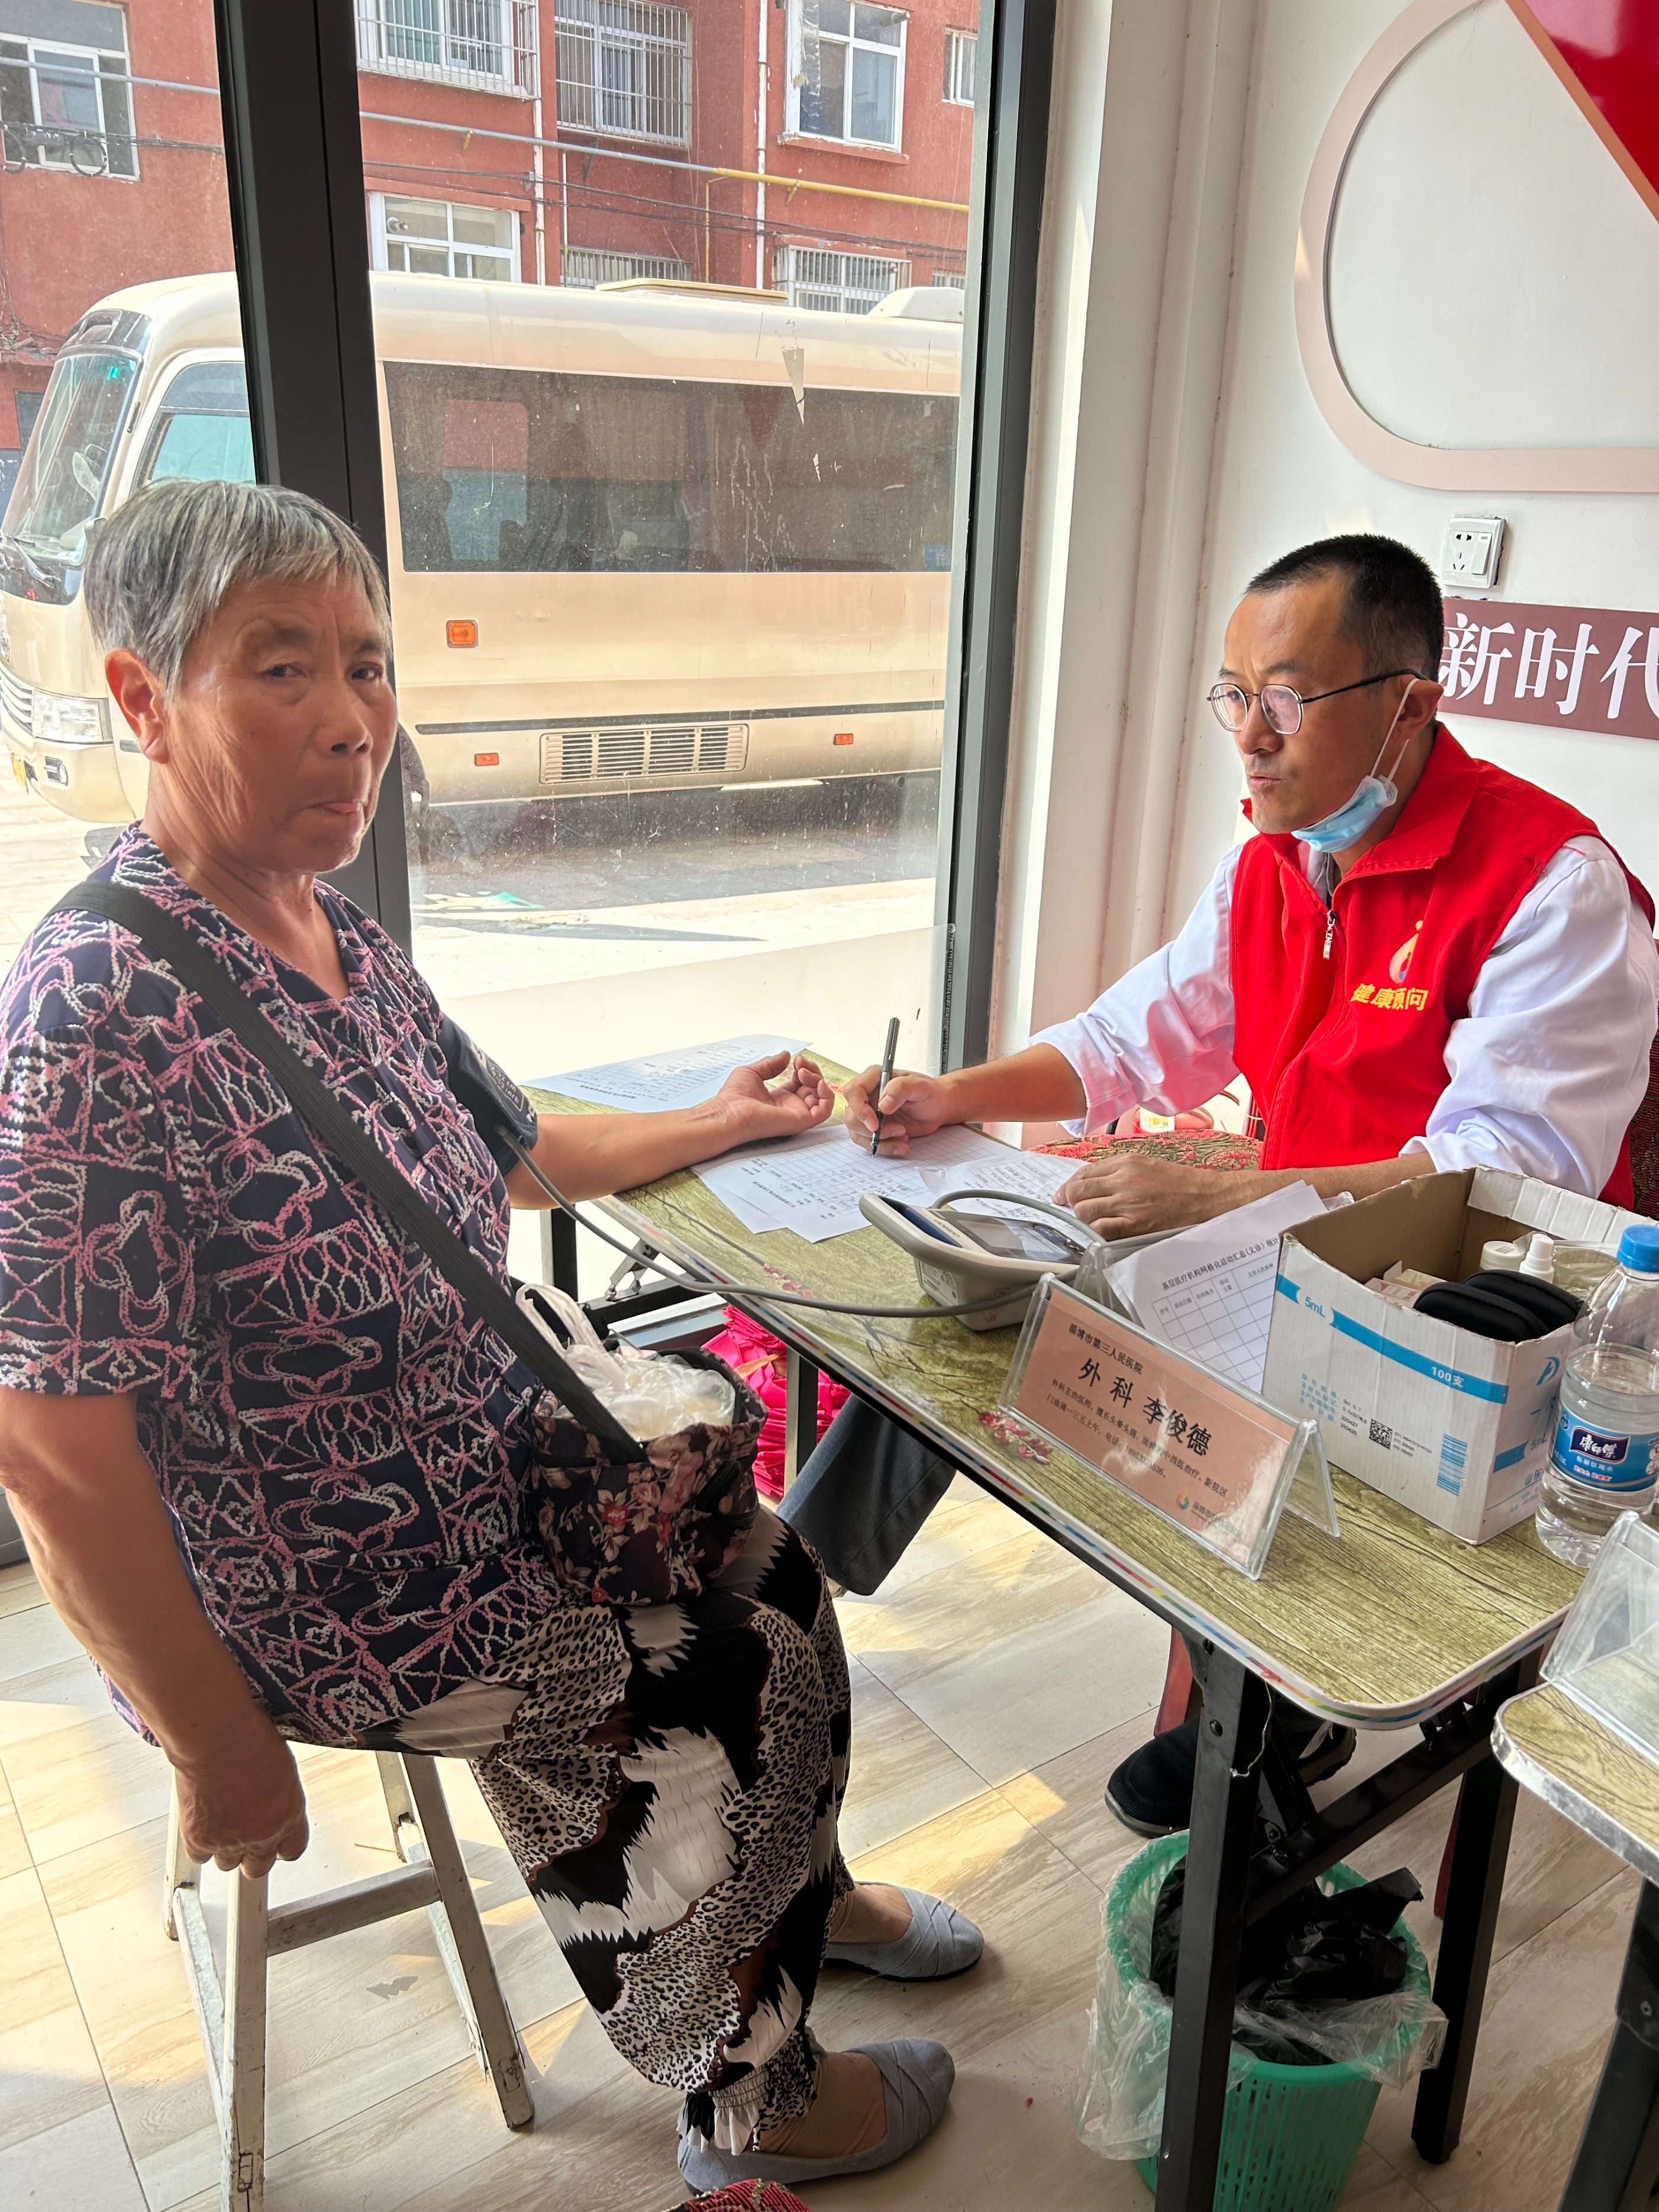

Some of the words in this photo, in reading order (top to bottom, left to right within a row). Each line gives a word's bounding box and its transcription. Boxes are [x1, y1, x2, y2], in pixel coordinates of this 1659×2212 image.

[1351, 983, 1429, 1011] 健康顾问
[1304, 1296, 1326, 1318] 5mL
[1069, 1323, 1144, 1375] 淄博市第三人民医院
[1431, 1366, 1464, 1388] 100支
